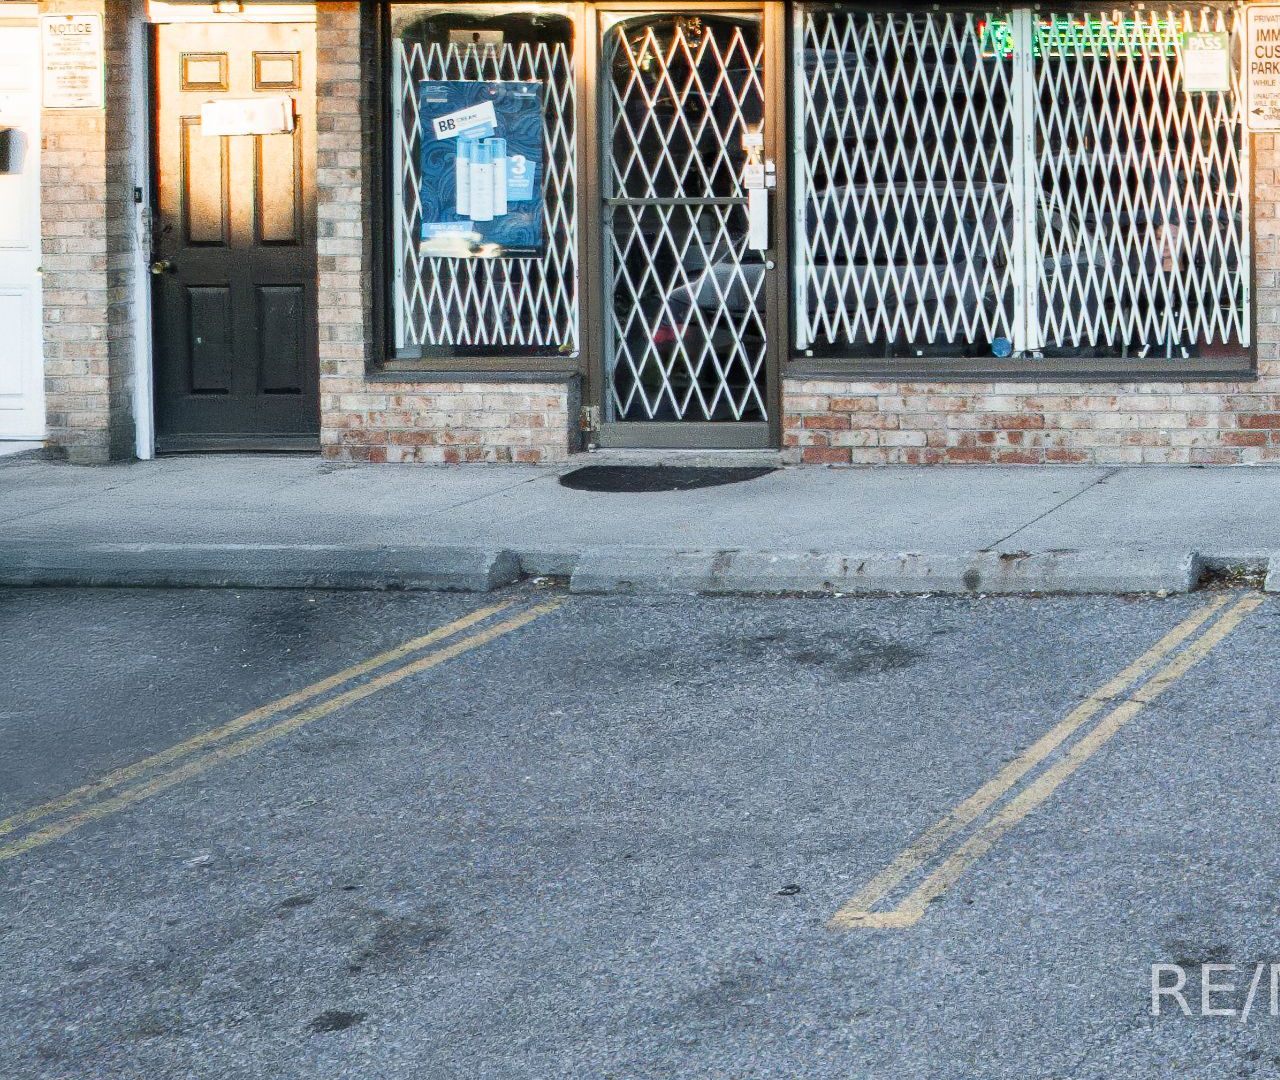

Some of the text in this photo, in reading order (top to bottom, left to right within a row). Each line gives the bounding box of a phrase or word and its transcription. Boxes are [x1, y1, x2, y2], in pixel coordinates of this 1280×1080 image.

[49, 23, 93, 33] NOTICE
[1188, 37, 1221, 50] PASS
[438, 118, 456, 133] BB
[511, 154, 527, 175] 3
